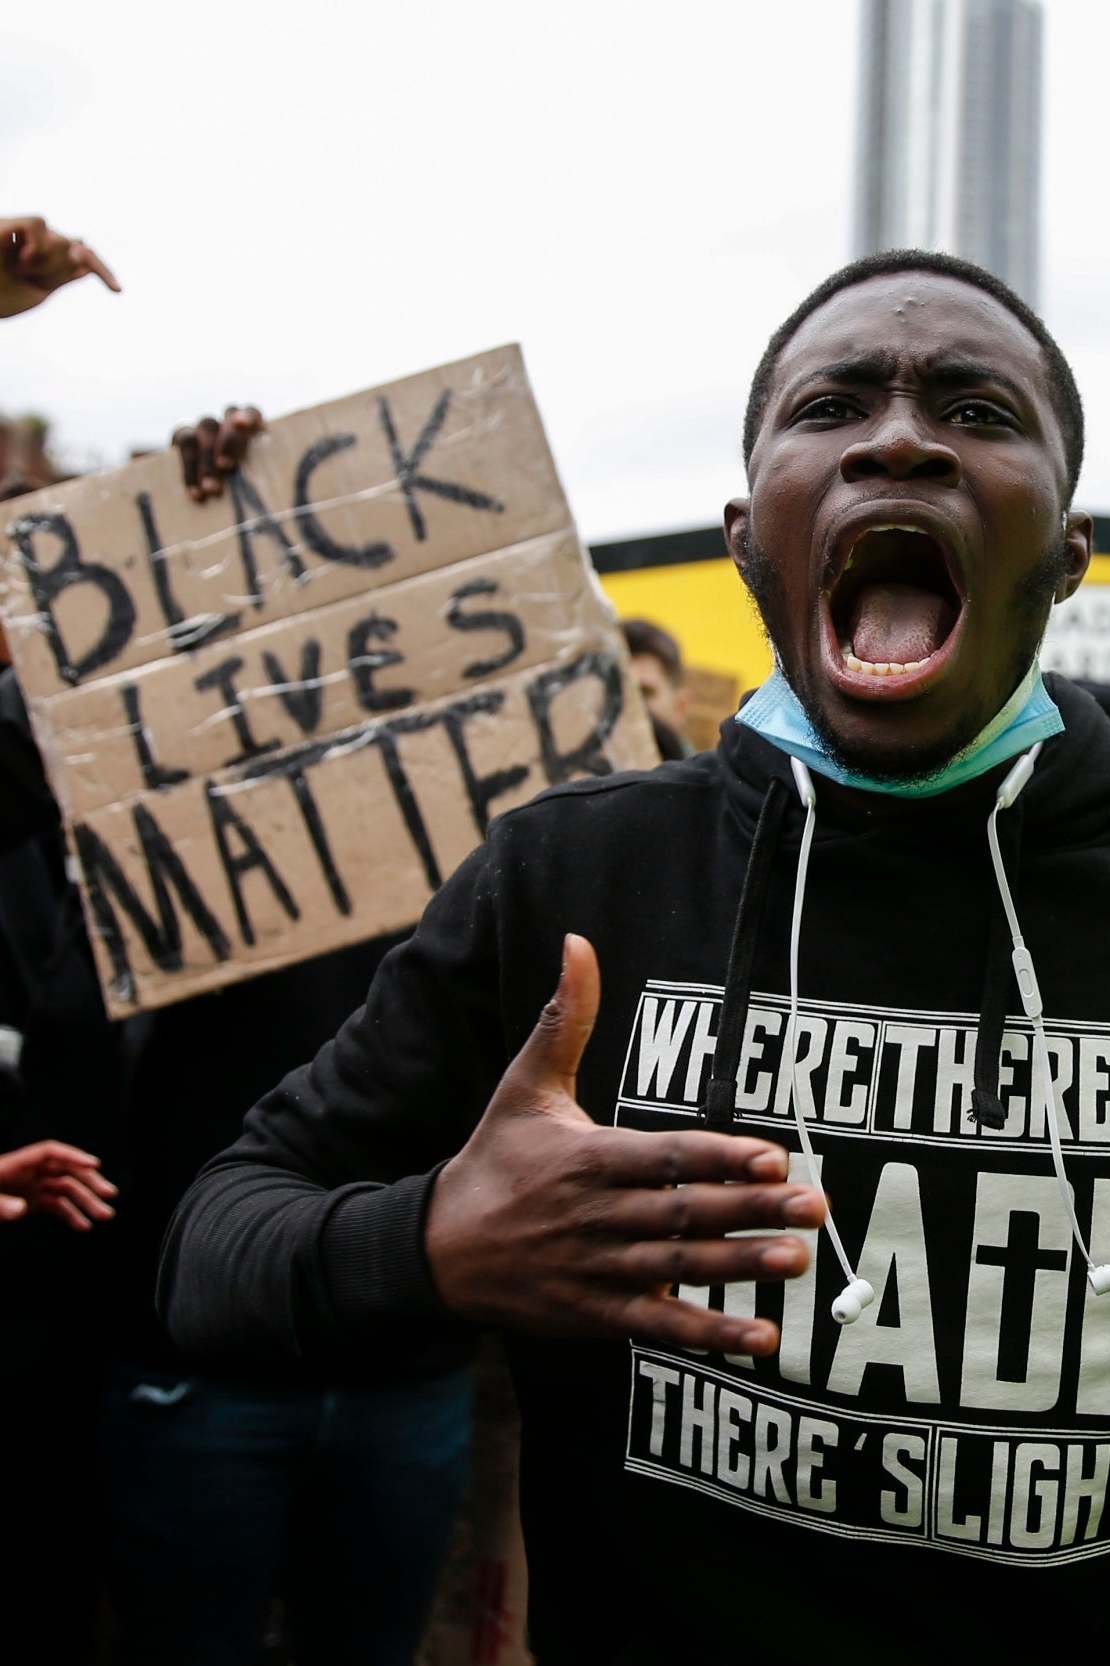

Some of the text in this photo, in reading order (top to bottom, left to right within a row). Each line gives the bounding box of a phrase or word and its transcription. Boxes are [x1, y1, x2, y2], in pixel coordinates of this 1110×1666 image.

[9, 388, 505, 687] BLACK
[119, 578, 525, 791] LIVES
[73, 650, 624, 1003] MATTER
[635, 997, 877, 1126] WHERE
[638, 1360, 926, 1529] THERE'S
